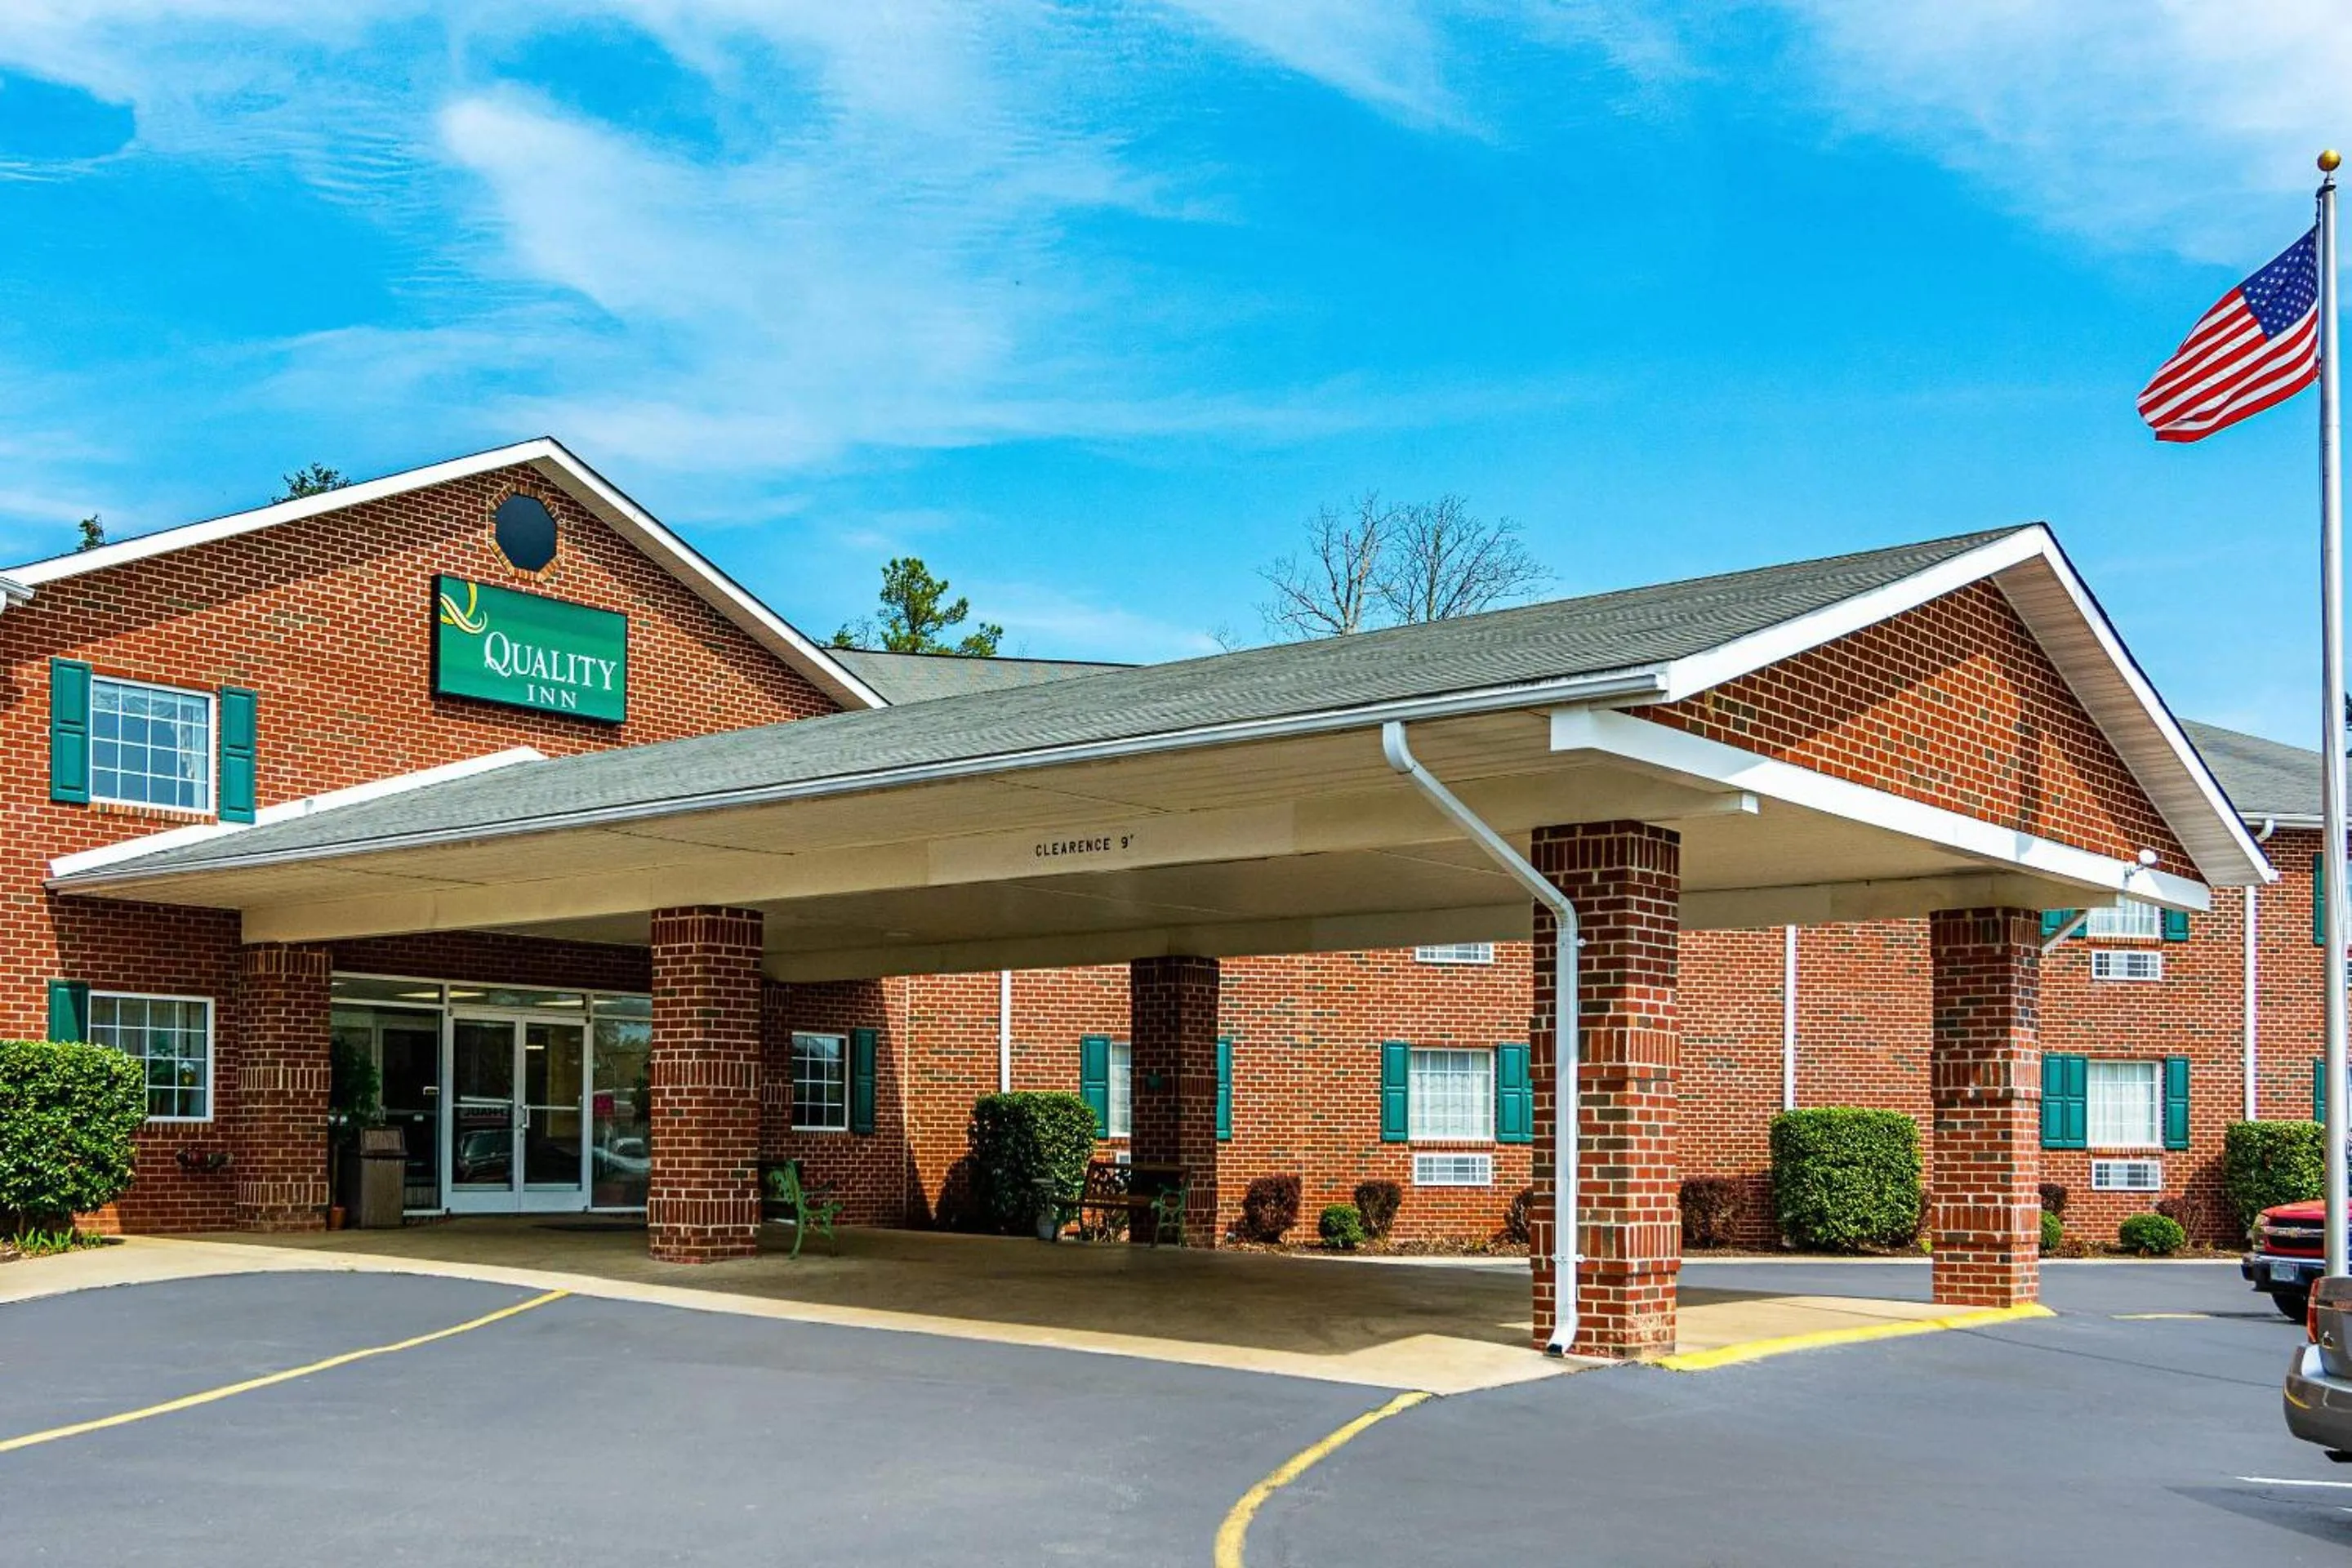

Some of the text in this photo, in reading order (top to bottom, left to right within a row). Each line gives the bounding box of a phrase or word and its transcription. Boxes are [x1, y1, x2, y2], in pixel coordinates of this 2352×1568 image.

[483, 631, 617, 691] QUALITY
[527, 684, 577, 709] INN
[1036, 838, 1111, 858] CLEARENCE
